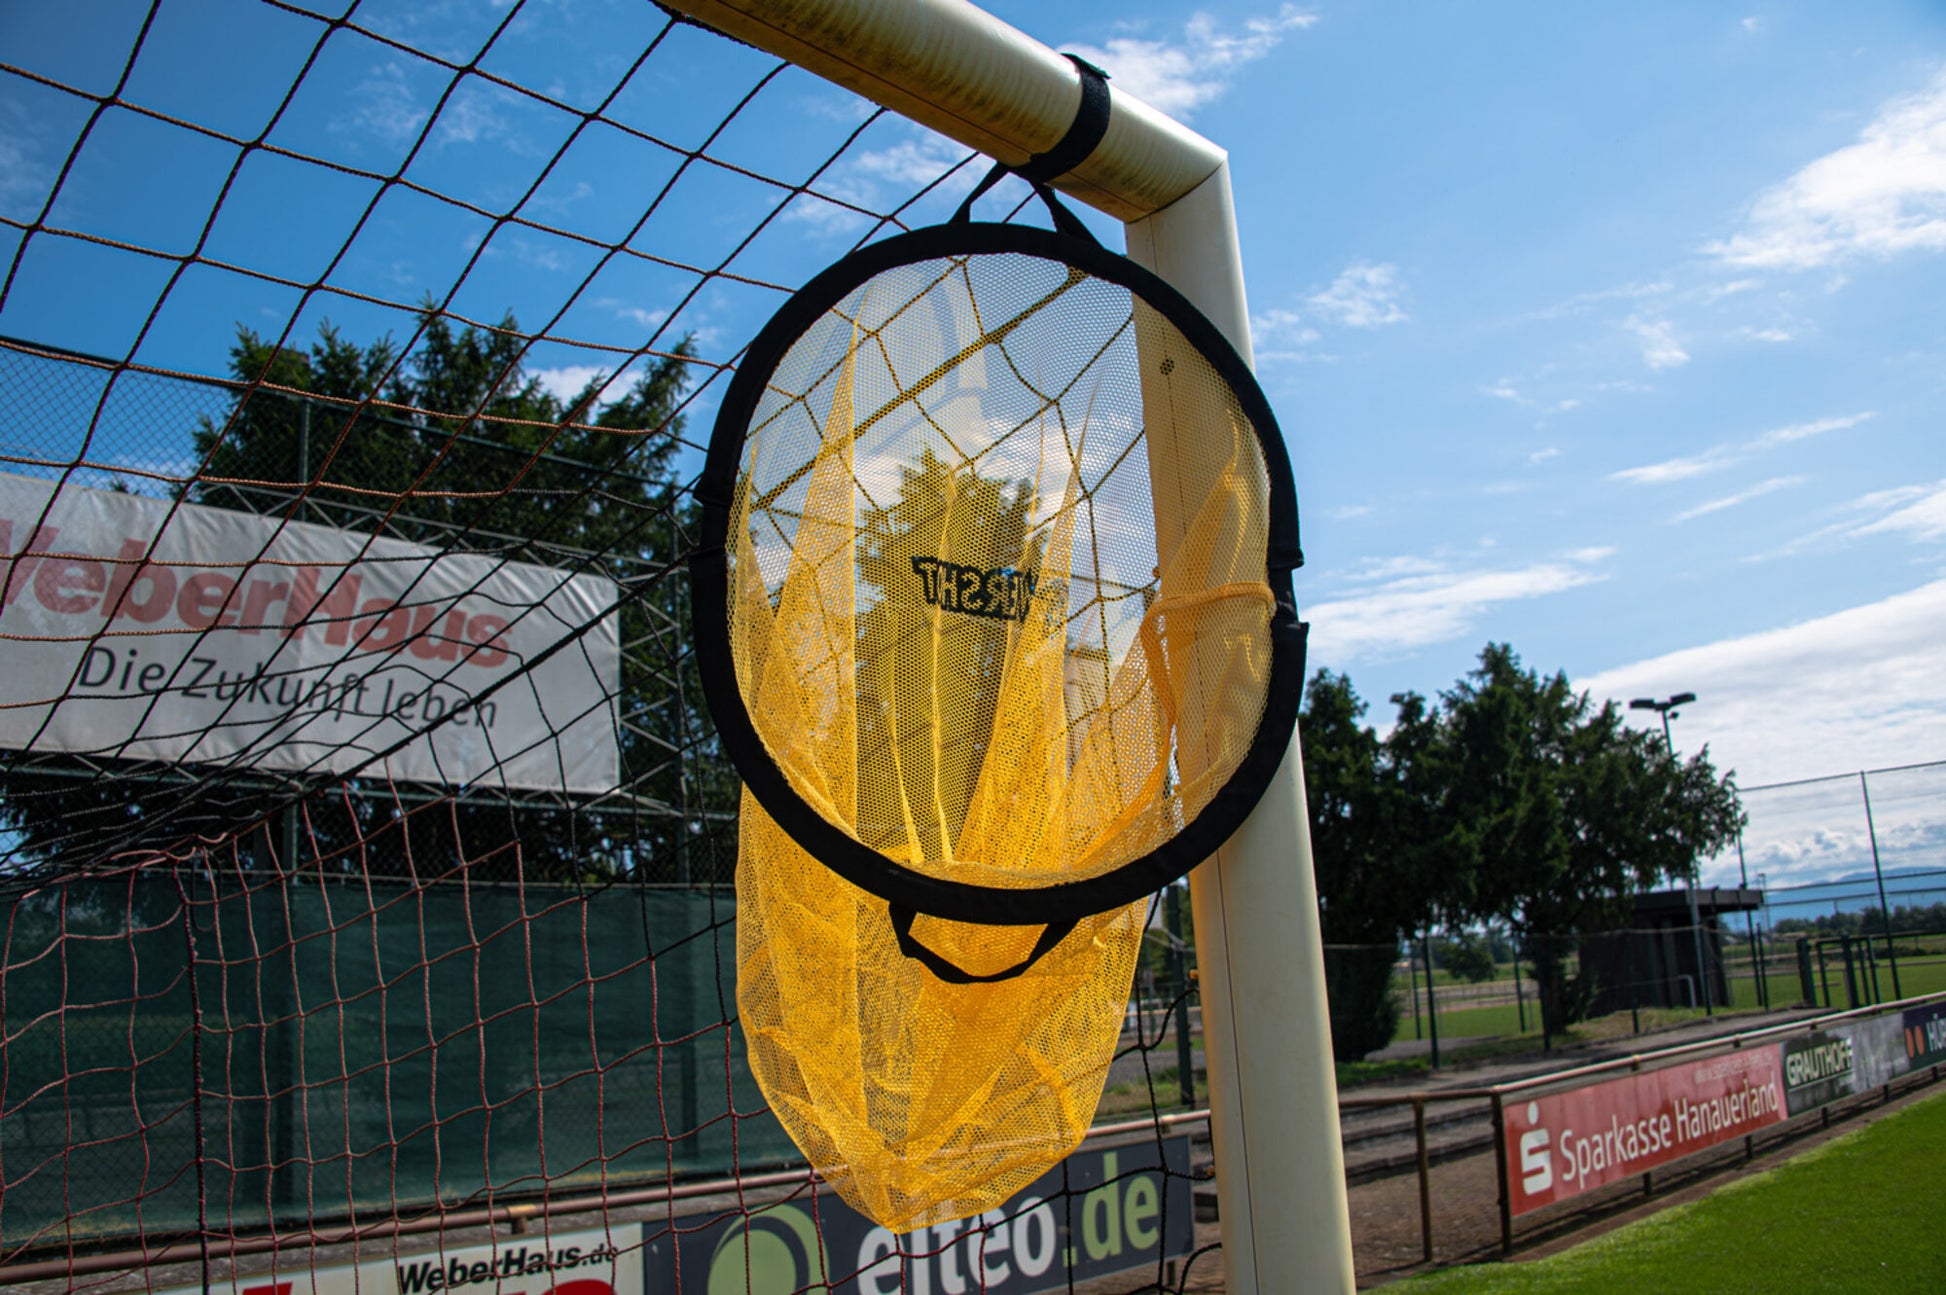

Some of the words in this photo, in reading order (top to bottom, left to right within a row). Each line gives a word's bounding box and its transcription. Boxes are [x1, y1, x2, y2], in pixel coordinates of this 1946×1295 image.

[79, 646, 167, 694] Die
[183, 657, 370, 721] Zukunft
[384, 678, 498, 729] leben
[1560, 1113, 1673, 1189] Sparkasse
[1674, 1071, 1779, 1143] Hanauerland
[398, 1242, 620, 1294] WeberHaus.de
